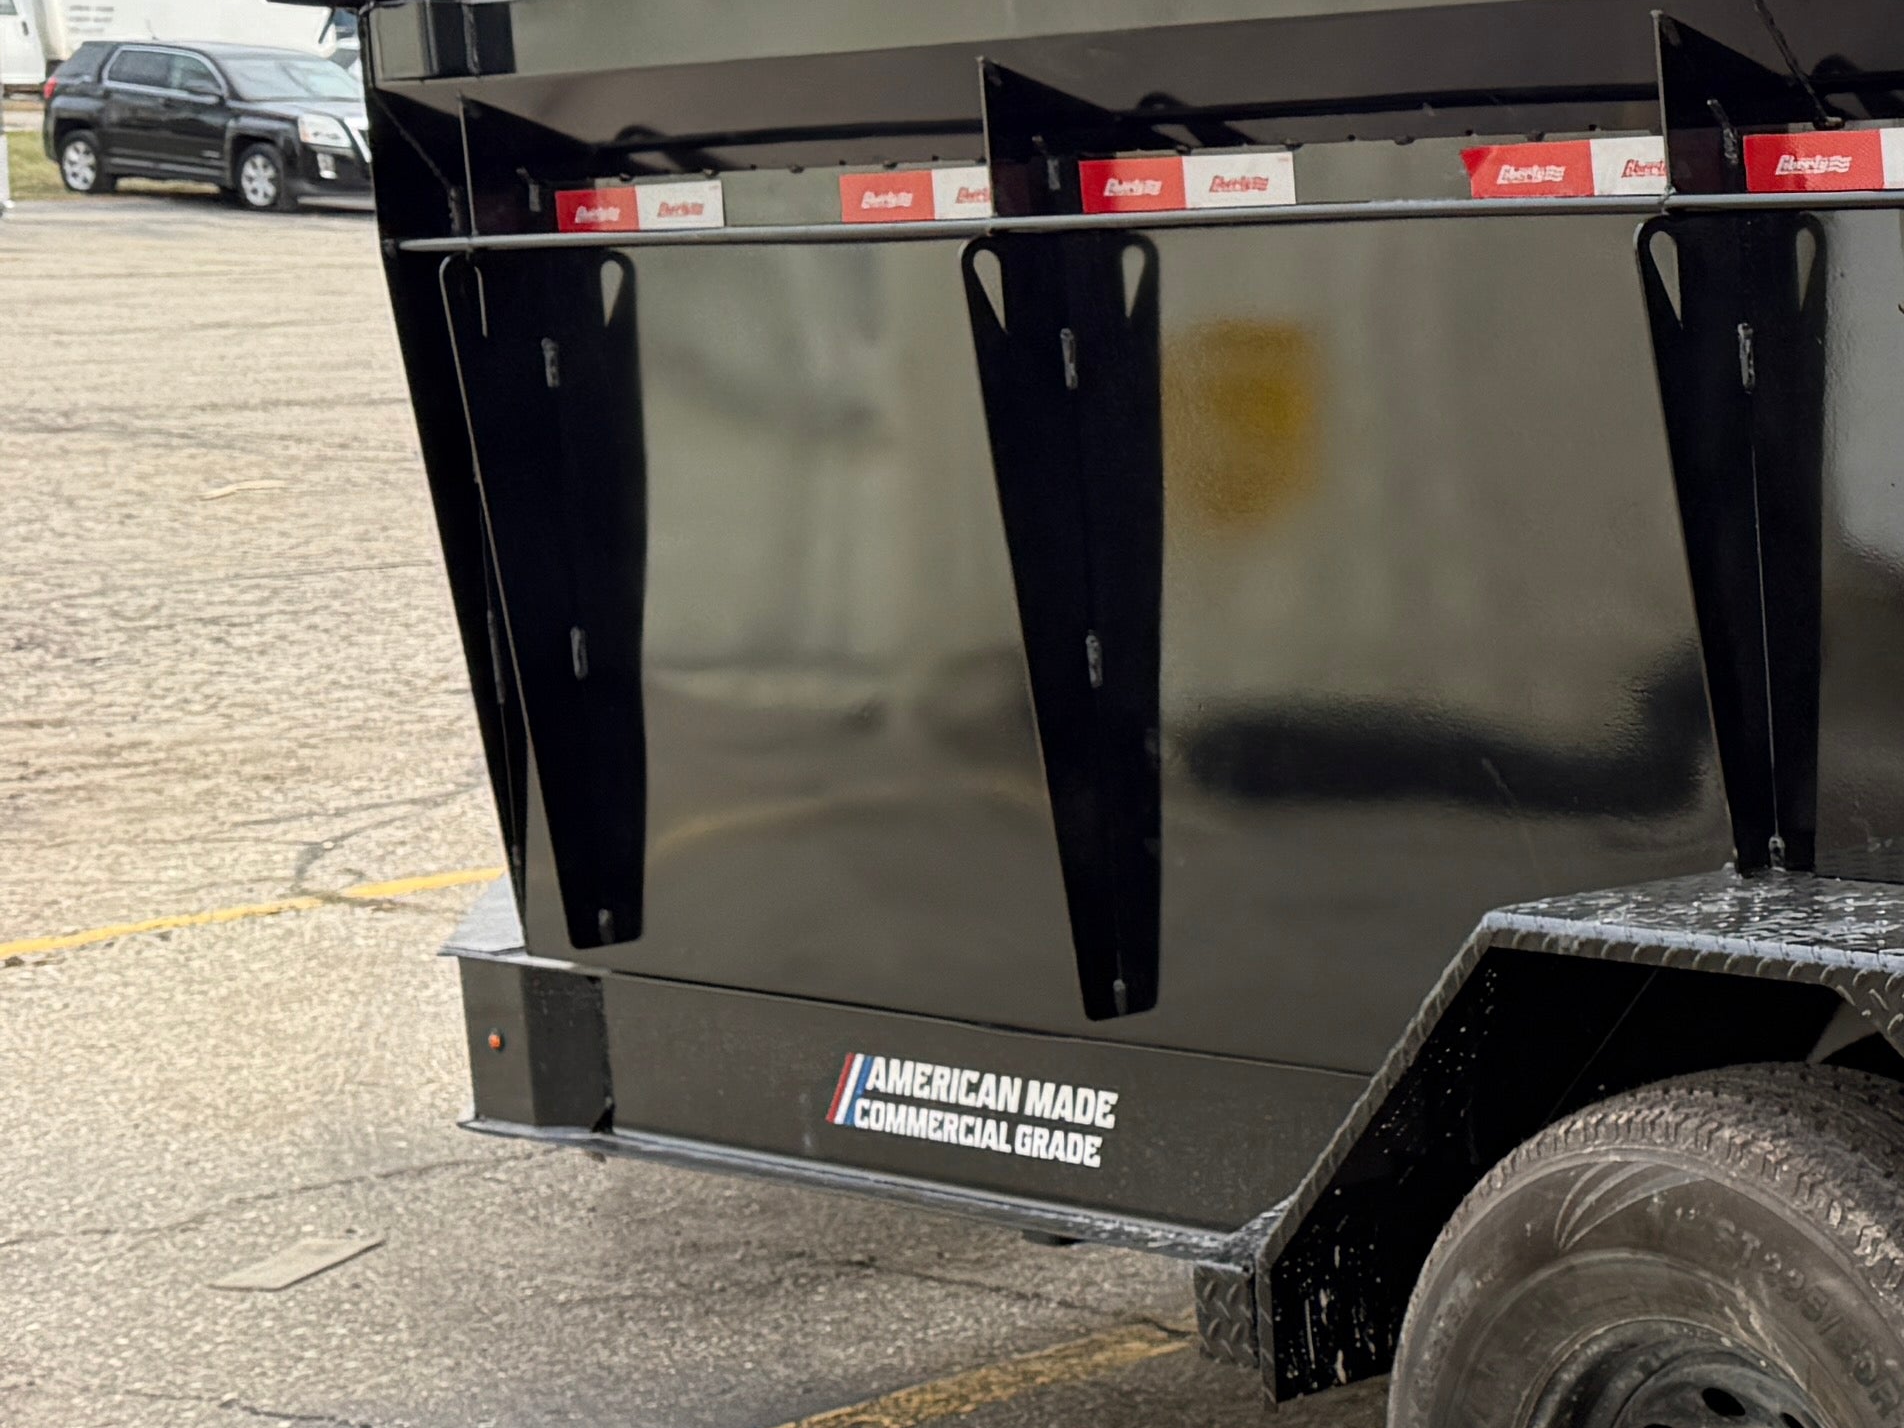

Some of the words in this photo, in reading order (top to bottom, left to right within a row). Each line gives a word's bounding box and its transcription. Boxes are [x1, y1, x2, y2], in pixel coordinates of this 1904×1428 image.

[866, 1056, 1022, 1113] AMERICAN
[1023, 1079, 1119, 1129] MADE
[854, 1098, 1012, 1154] COMMERCIAL
[1015, 1123, 1103, 1168] GRADE
